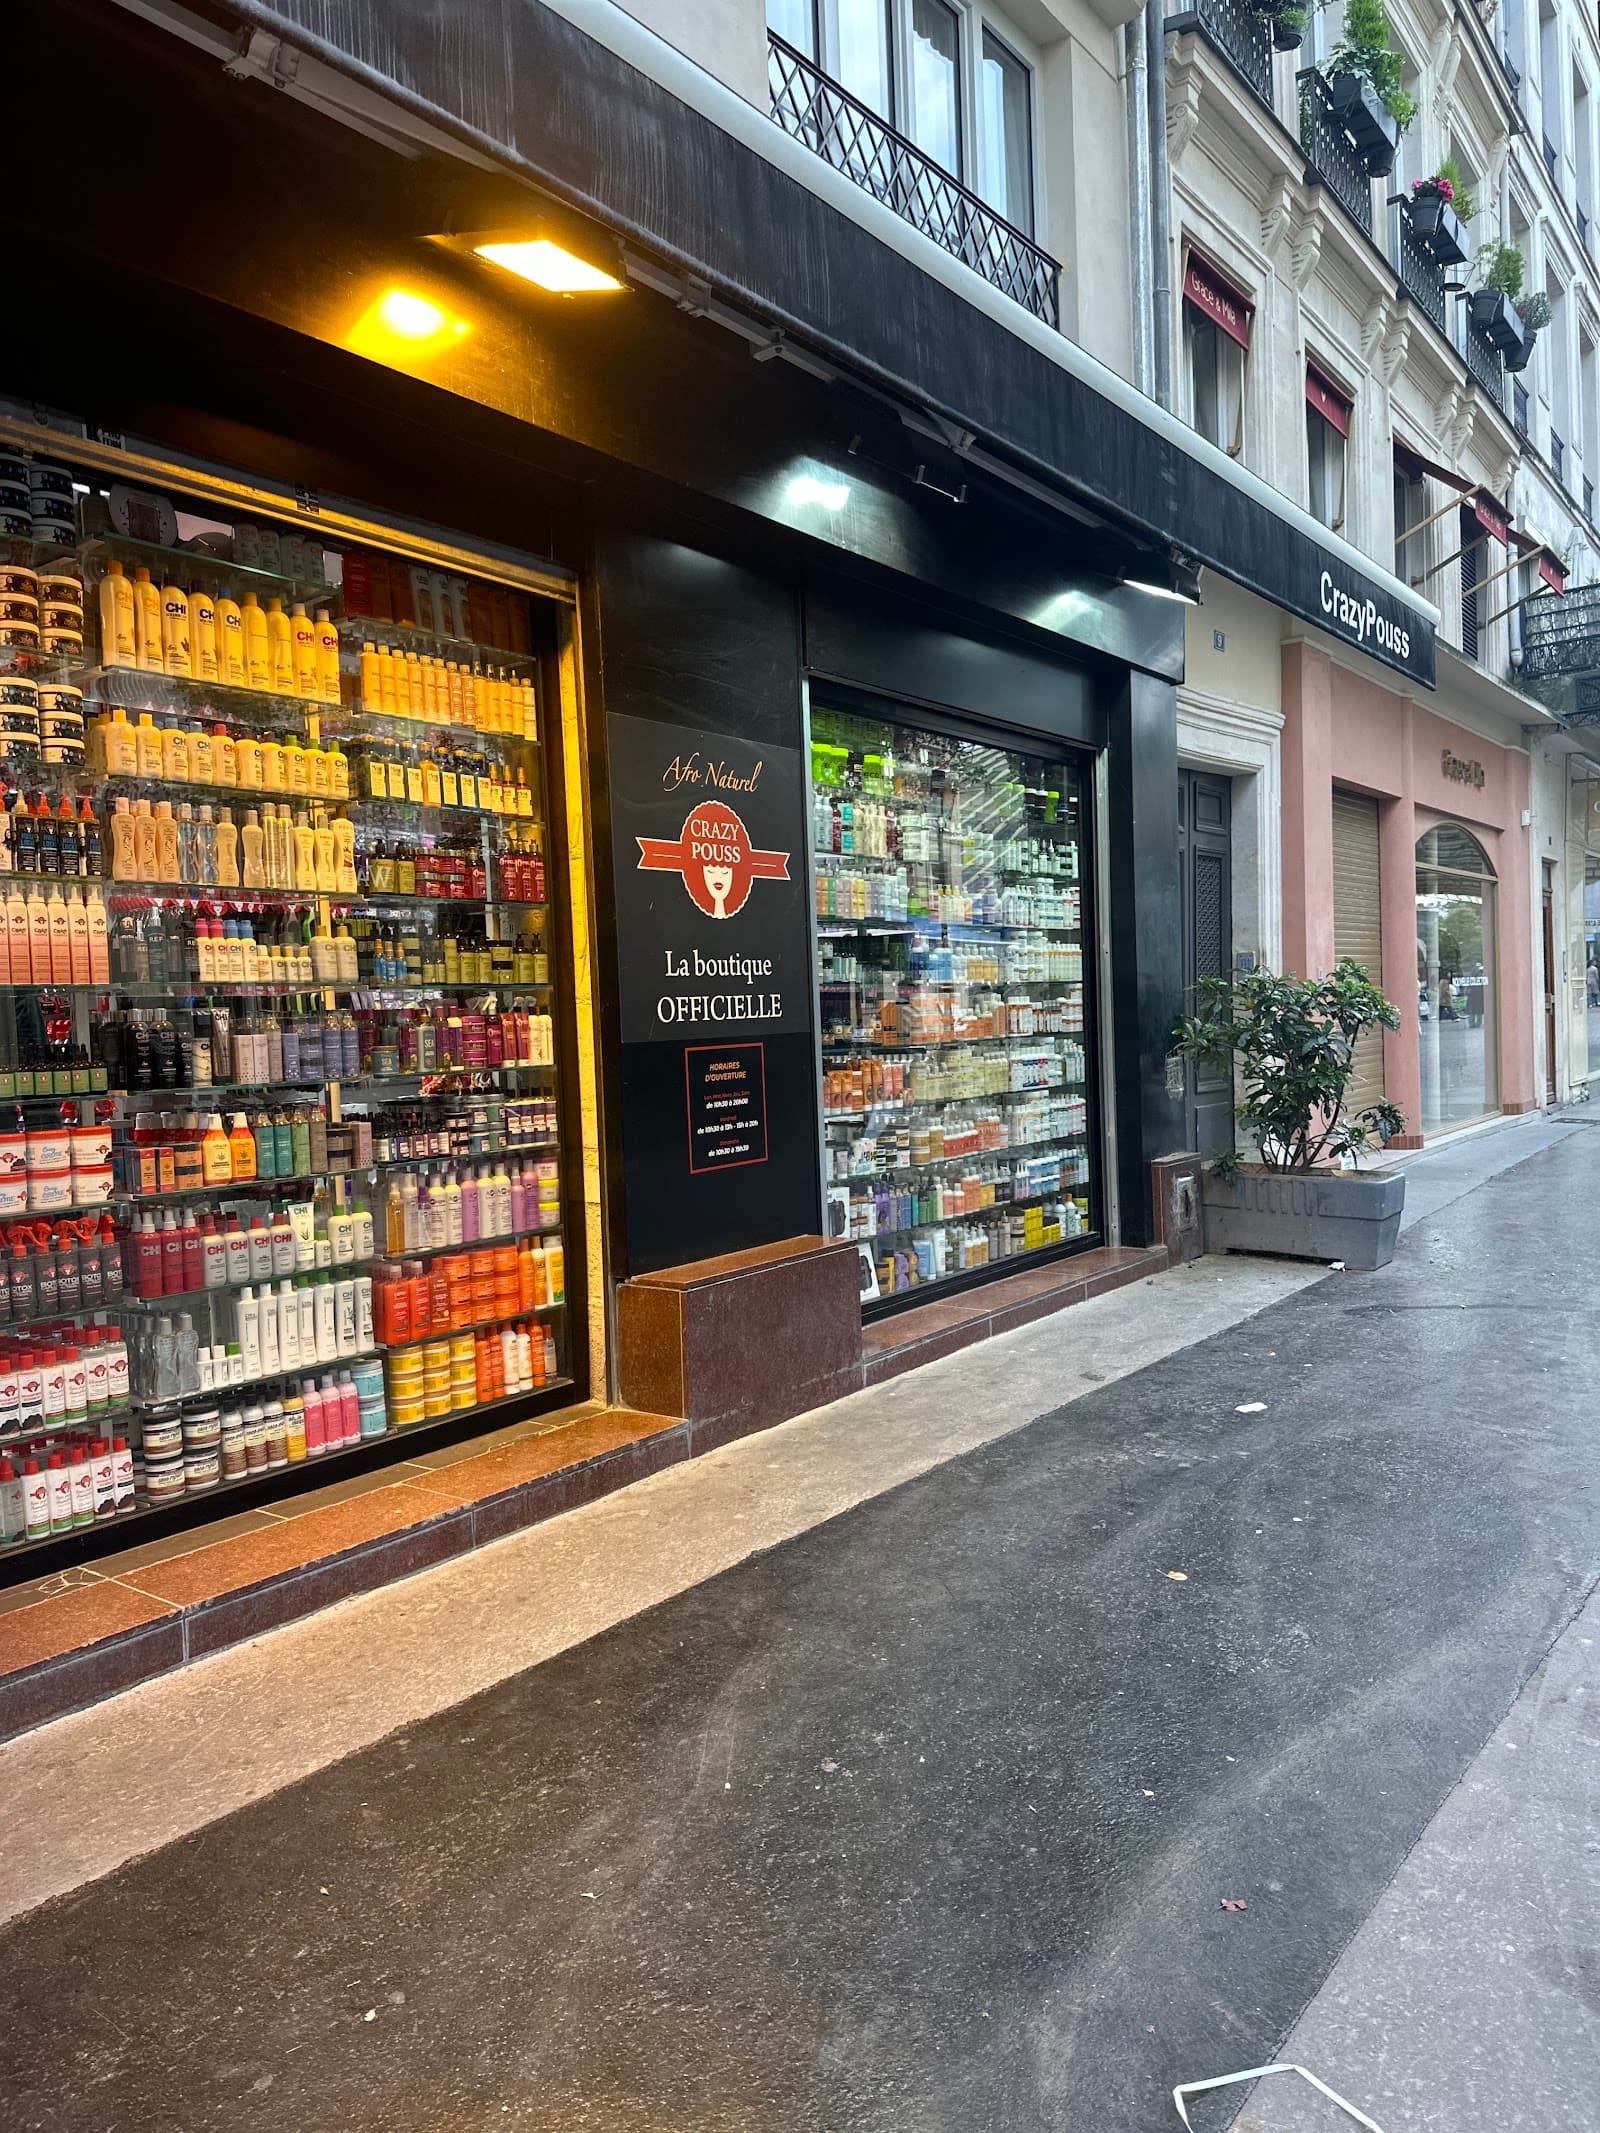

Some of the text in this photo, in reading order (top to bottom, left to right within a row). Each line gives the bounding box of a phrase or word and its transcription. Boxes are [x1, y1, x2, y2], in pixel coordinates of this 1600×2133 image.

[166, 602, 187, 615] CHI
[199, 608, 215, 620] CH
[1321, 571, 1410, 658] CrazyPouss
[226, 614, 241, 627] CH
[662, 752, 763, 792] Afro Naturel
[690, 819, 740, 841] CRAZY
[691, 841, 741, 863] POUSS
[665, 949, 773, 985] La boutique
[657, 994, 783, 1023] OFFICIELLE
[709, 1061, 740, 1071] HORAIRES
[705, 1071, 747, 1082] D'OUVERTURE
[706, 1101, 713, 1109] de
[697, 1127, 704, 1135] de
[294, 1207, 308, 1215] CHI
[274, 1233, 292, 1244] CHI
[82, 1273, 101, 1282] BOTO
